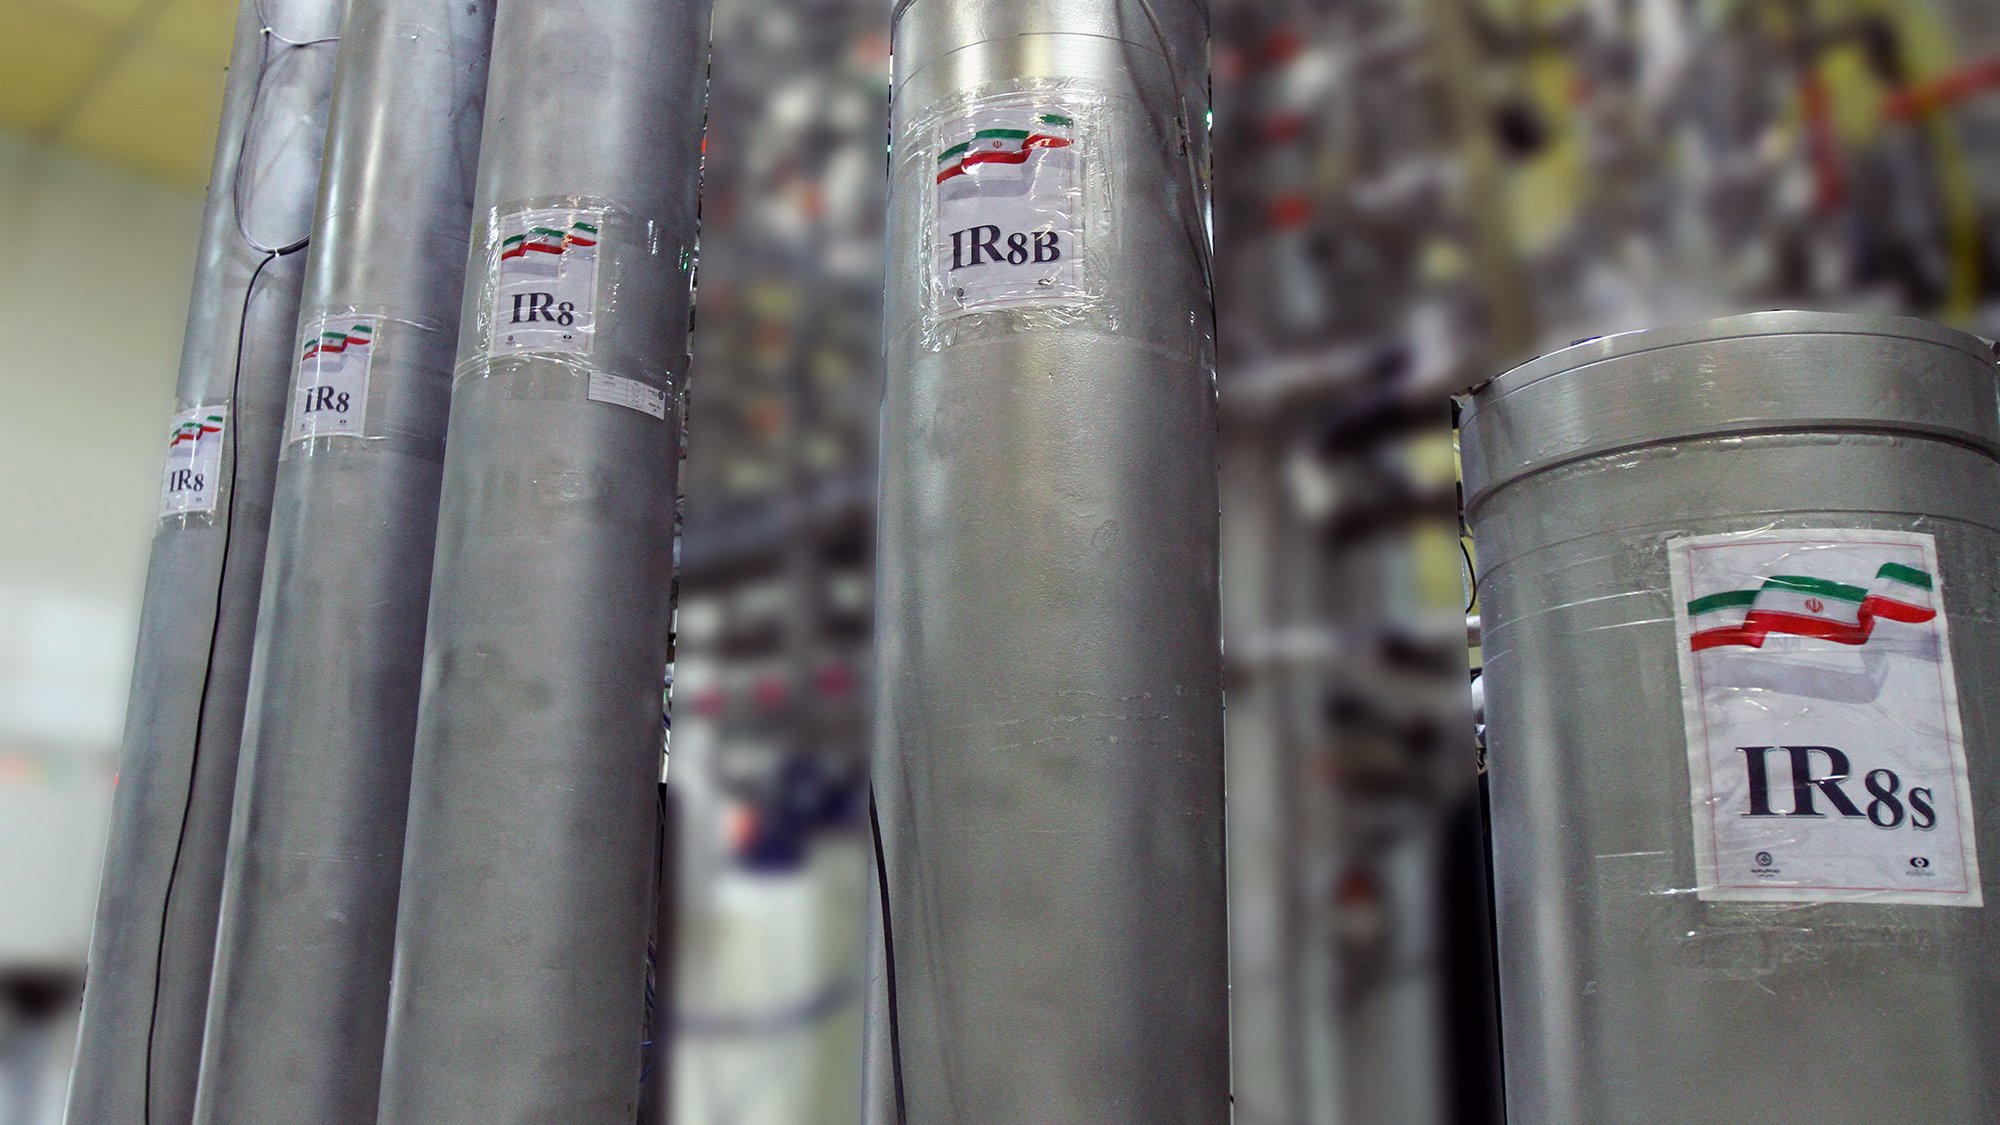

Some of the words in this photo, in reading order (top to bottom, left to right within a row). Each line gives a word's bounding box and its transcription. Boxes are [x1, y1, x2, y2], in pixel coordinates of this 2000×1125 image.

[949, 224, 1060, 272] IR8B
[510, 292, 574, 326] IR8
[304, 386, 350, 413] IR8
[169, 469, 204, 492] IR8
[1735, 745, 1937, 831] IR8s
